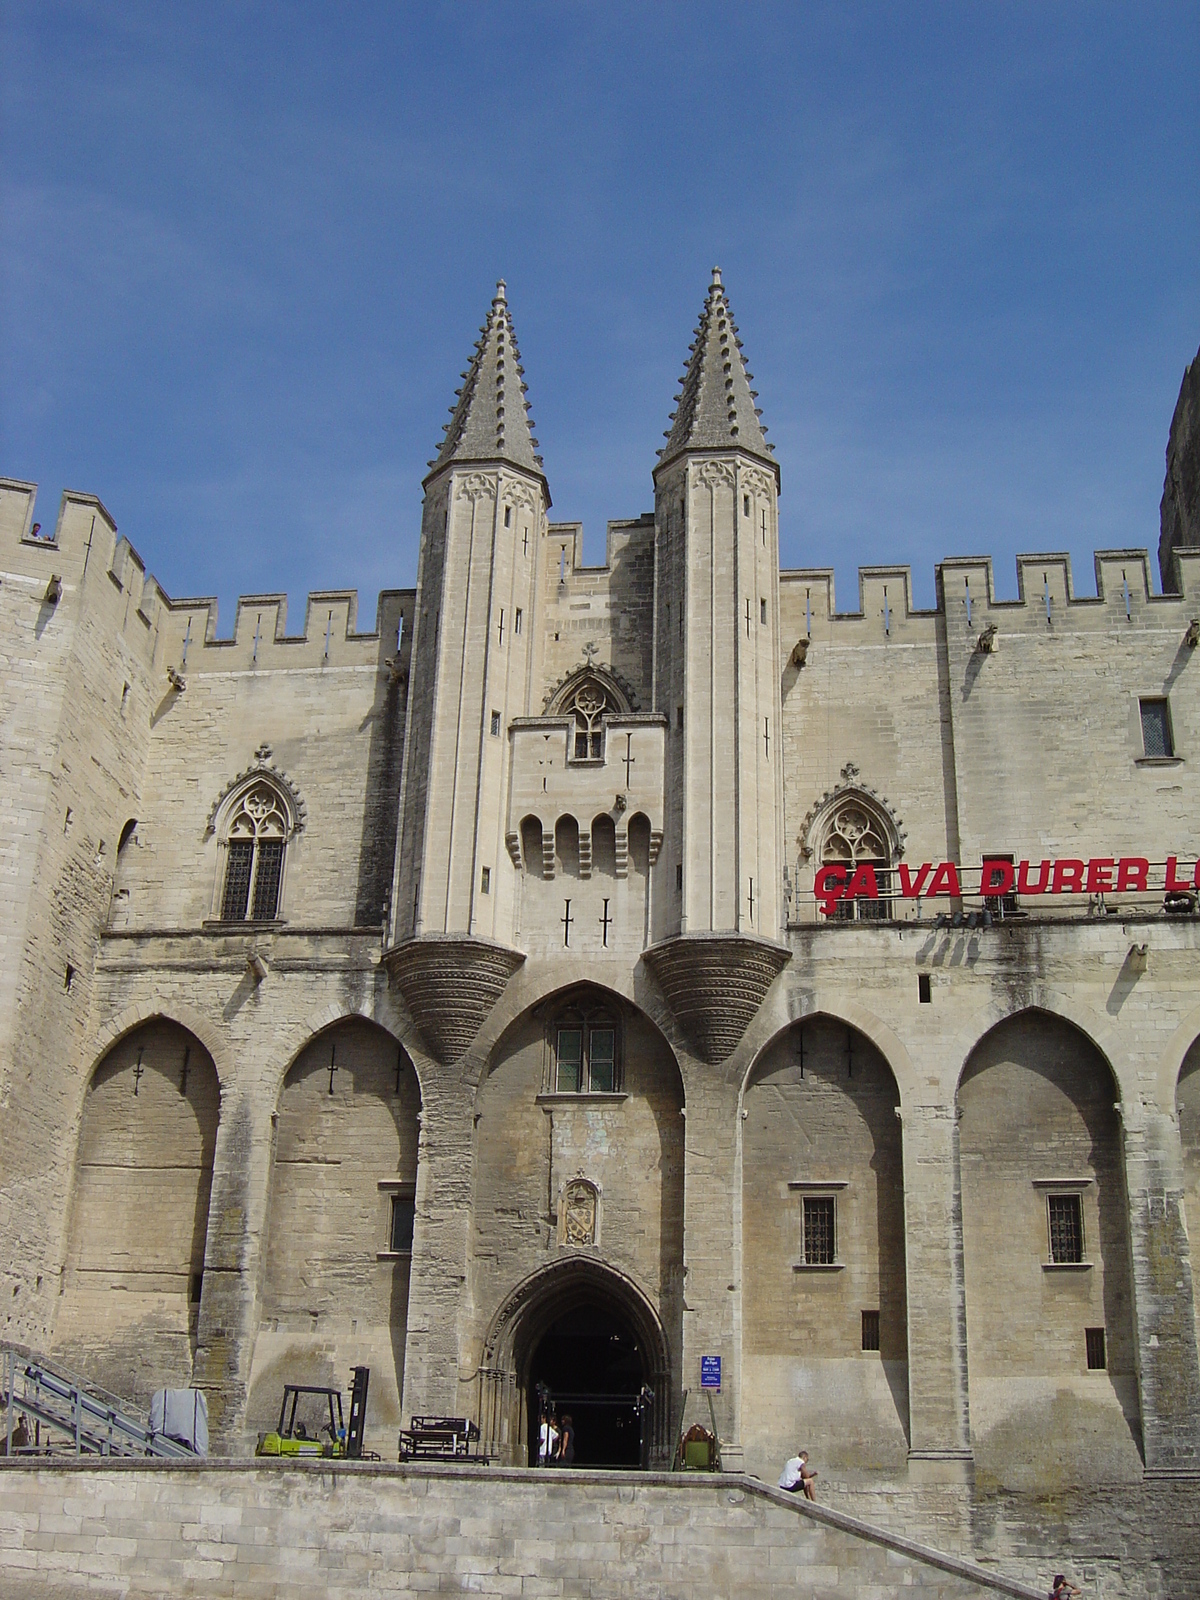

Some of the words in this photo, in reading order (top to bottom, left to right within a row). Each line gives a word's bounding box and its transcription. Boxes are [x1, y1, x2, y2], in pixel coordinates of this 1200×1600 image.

[814, 864, 879, 915] ÇA
[899, 862, 961, 897] VA
[980, 857, 1150, 896] DURER
[1165, 856, 1200, 891] L
